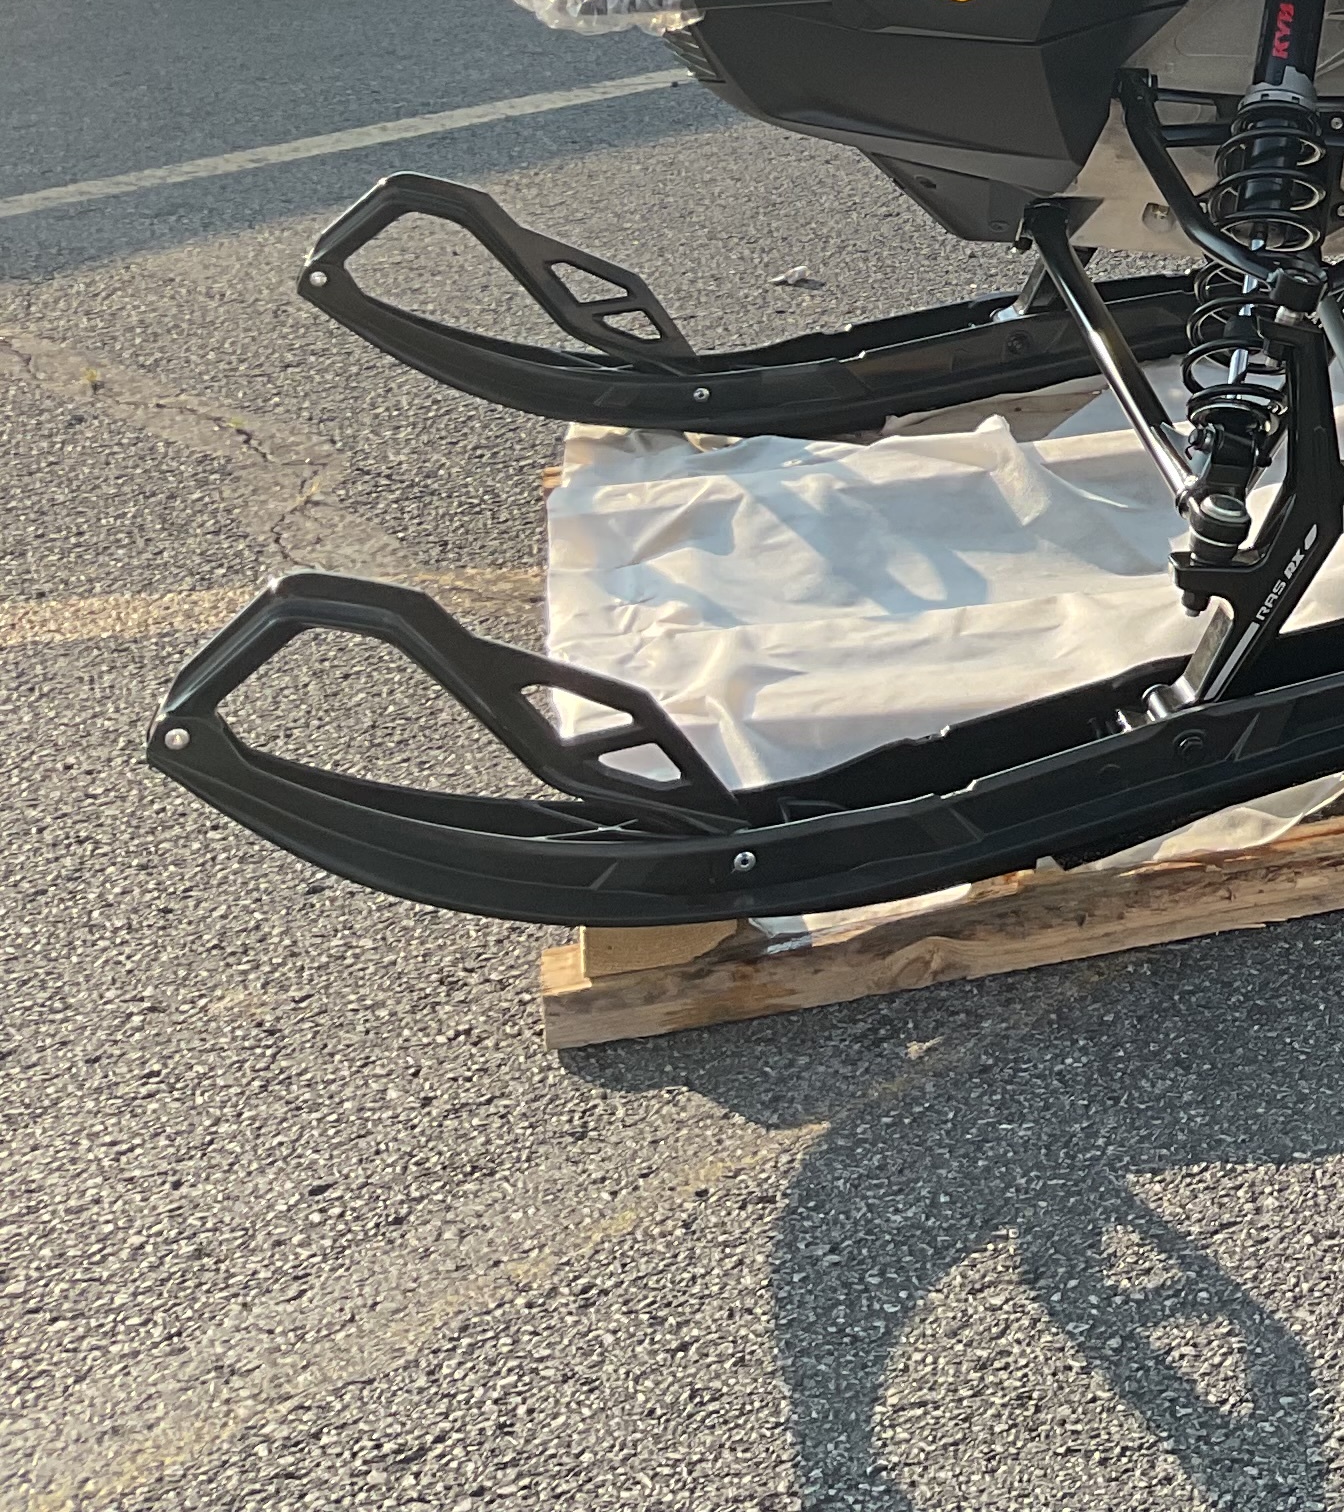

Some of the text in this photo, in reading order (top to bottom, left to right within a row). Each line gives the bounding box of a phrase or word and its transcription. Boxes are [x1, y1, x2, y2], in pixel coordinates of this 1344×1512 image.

[1272, 2, 1295, 59] KYB
[1256, 548, 1305, 621] RAS RX
